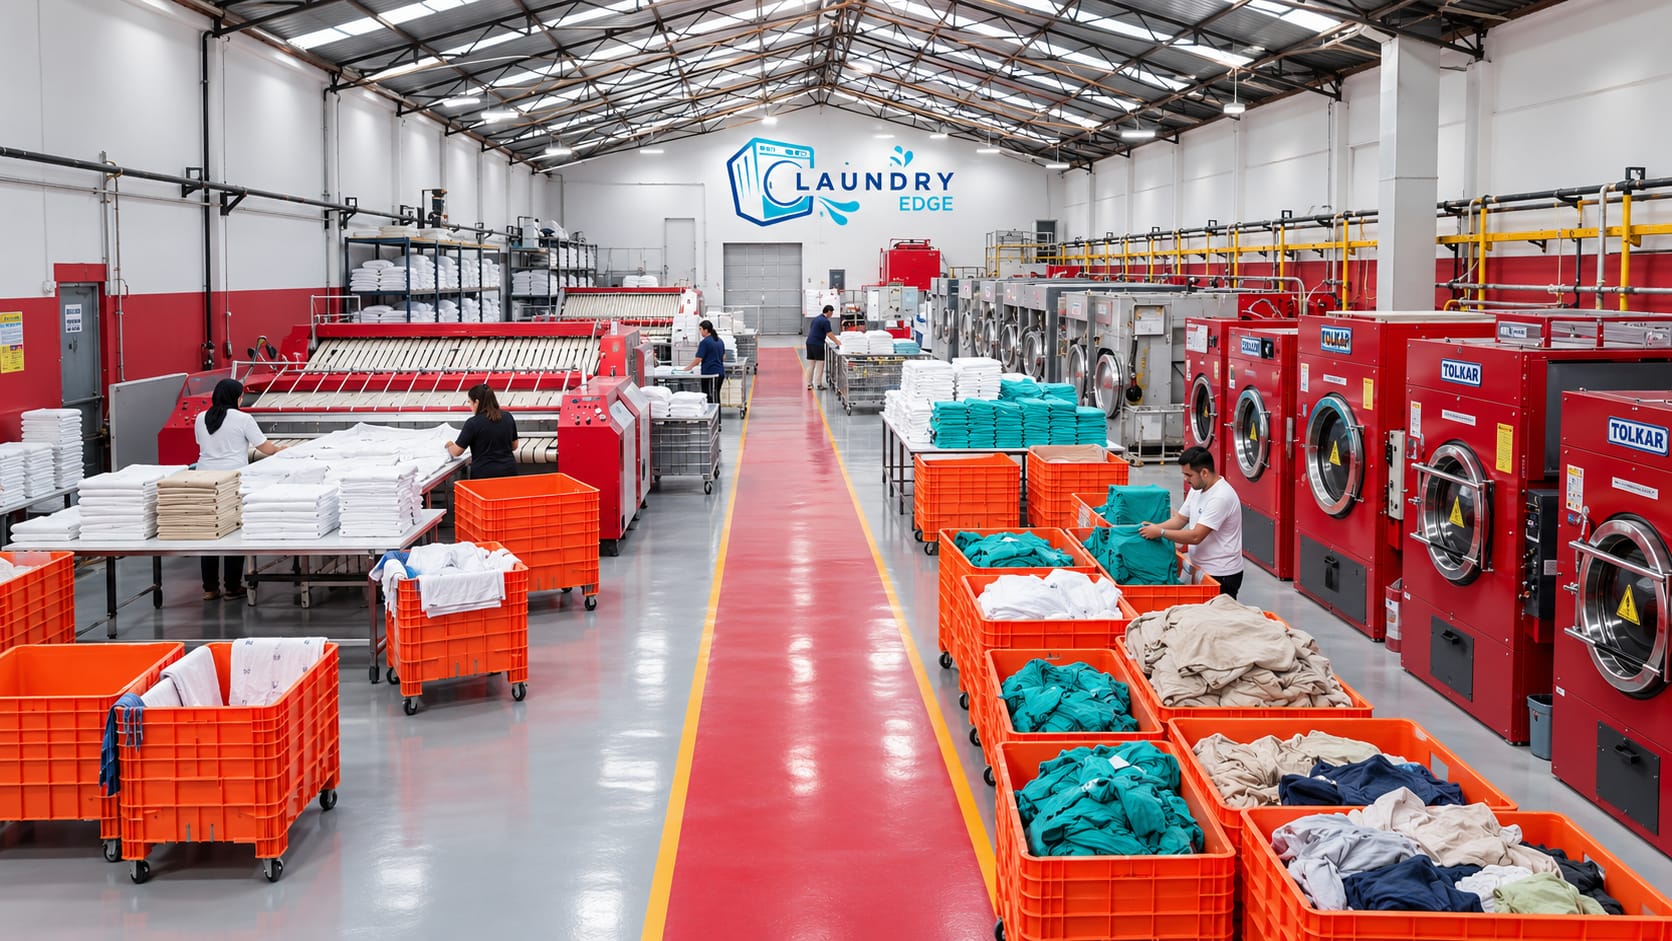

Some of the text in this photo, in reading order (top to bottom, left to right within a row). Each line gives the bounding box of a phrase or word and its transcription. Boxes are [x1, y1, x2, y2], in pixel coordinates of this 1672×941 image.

[796, 172, 954, 191] LAUNDRY
[900, 196, 953, 211] EDGE
[1443, 363, 1478, 382] TOLKAR
[1611, 422, 1663, 449] TOLKAR
